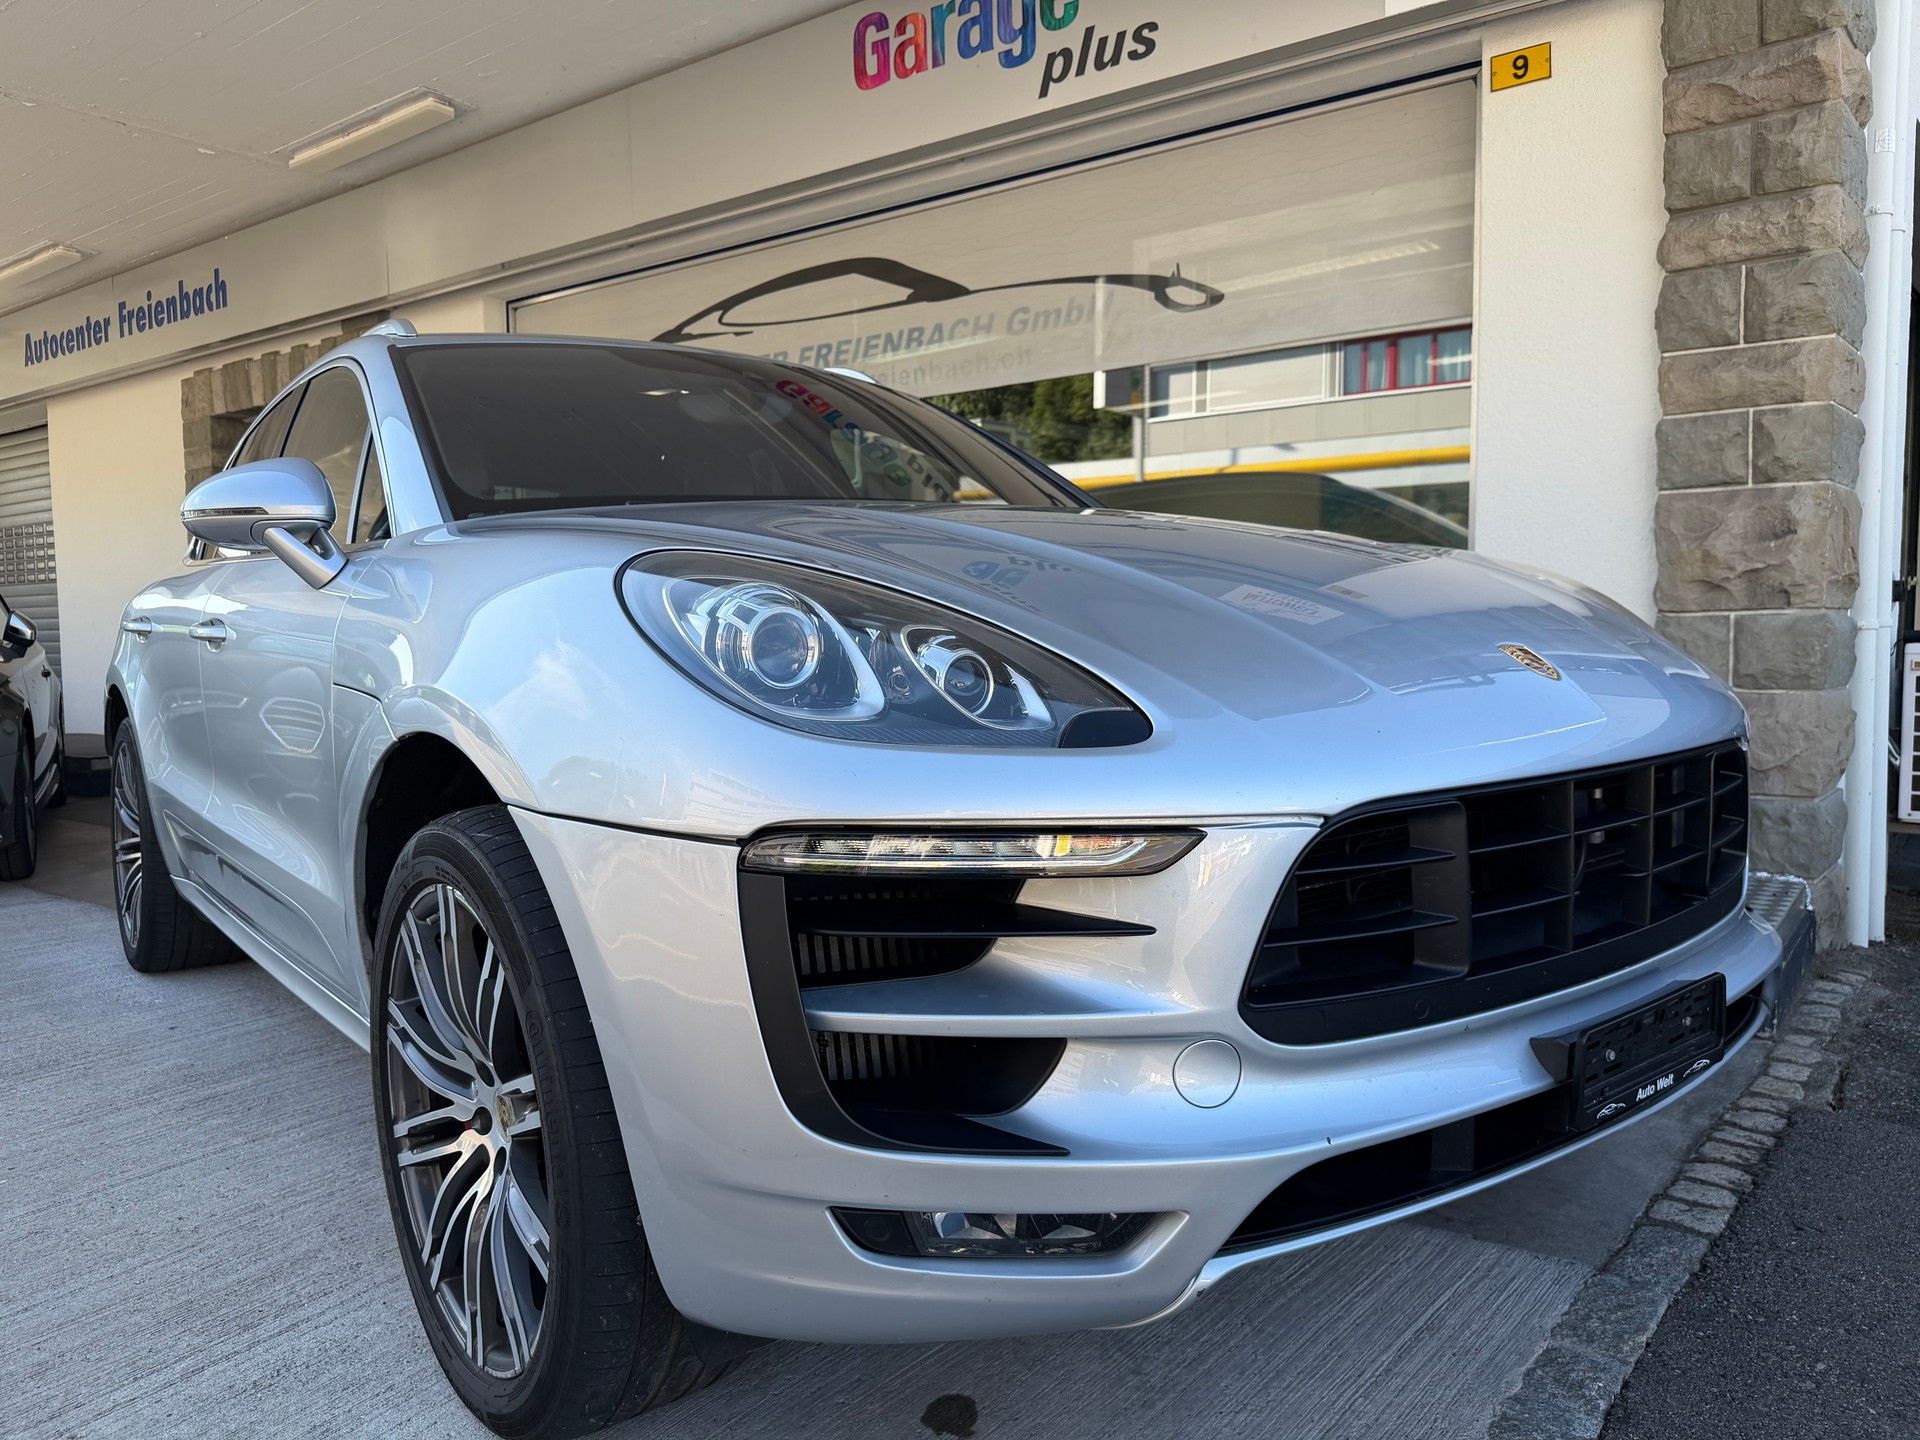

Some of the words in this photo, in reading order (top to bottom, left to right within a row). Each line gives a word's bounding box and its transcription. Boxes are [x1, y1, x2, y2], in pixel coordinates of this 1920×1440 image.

[1038, 21, 1159, 99] plus
[1512, 54, 1529, 80] 9
[24, 316, 111, 368] Autocenter
[117, 268, 228, 338] Freienbach
[799, 312, 996, 368] FREIENBACH
[1006, 289, 1114, 337] GmbH
[1636, 1084, 1655, 1101] Auto
[1656, 1073, 1674, 1091] Welt
